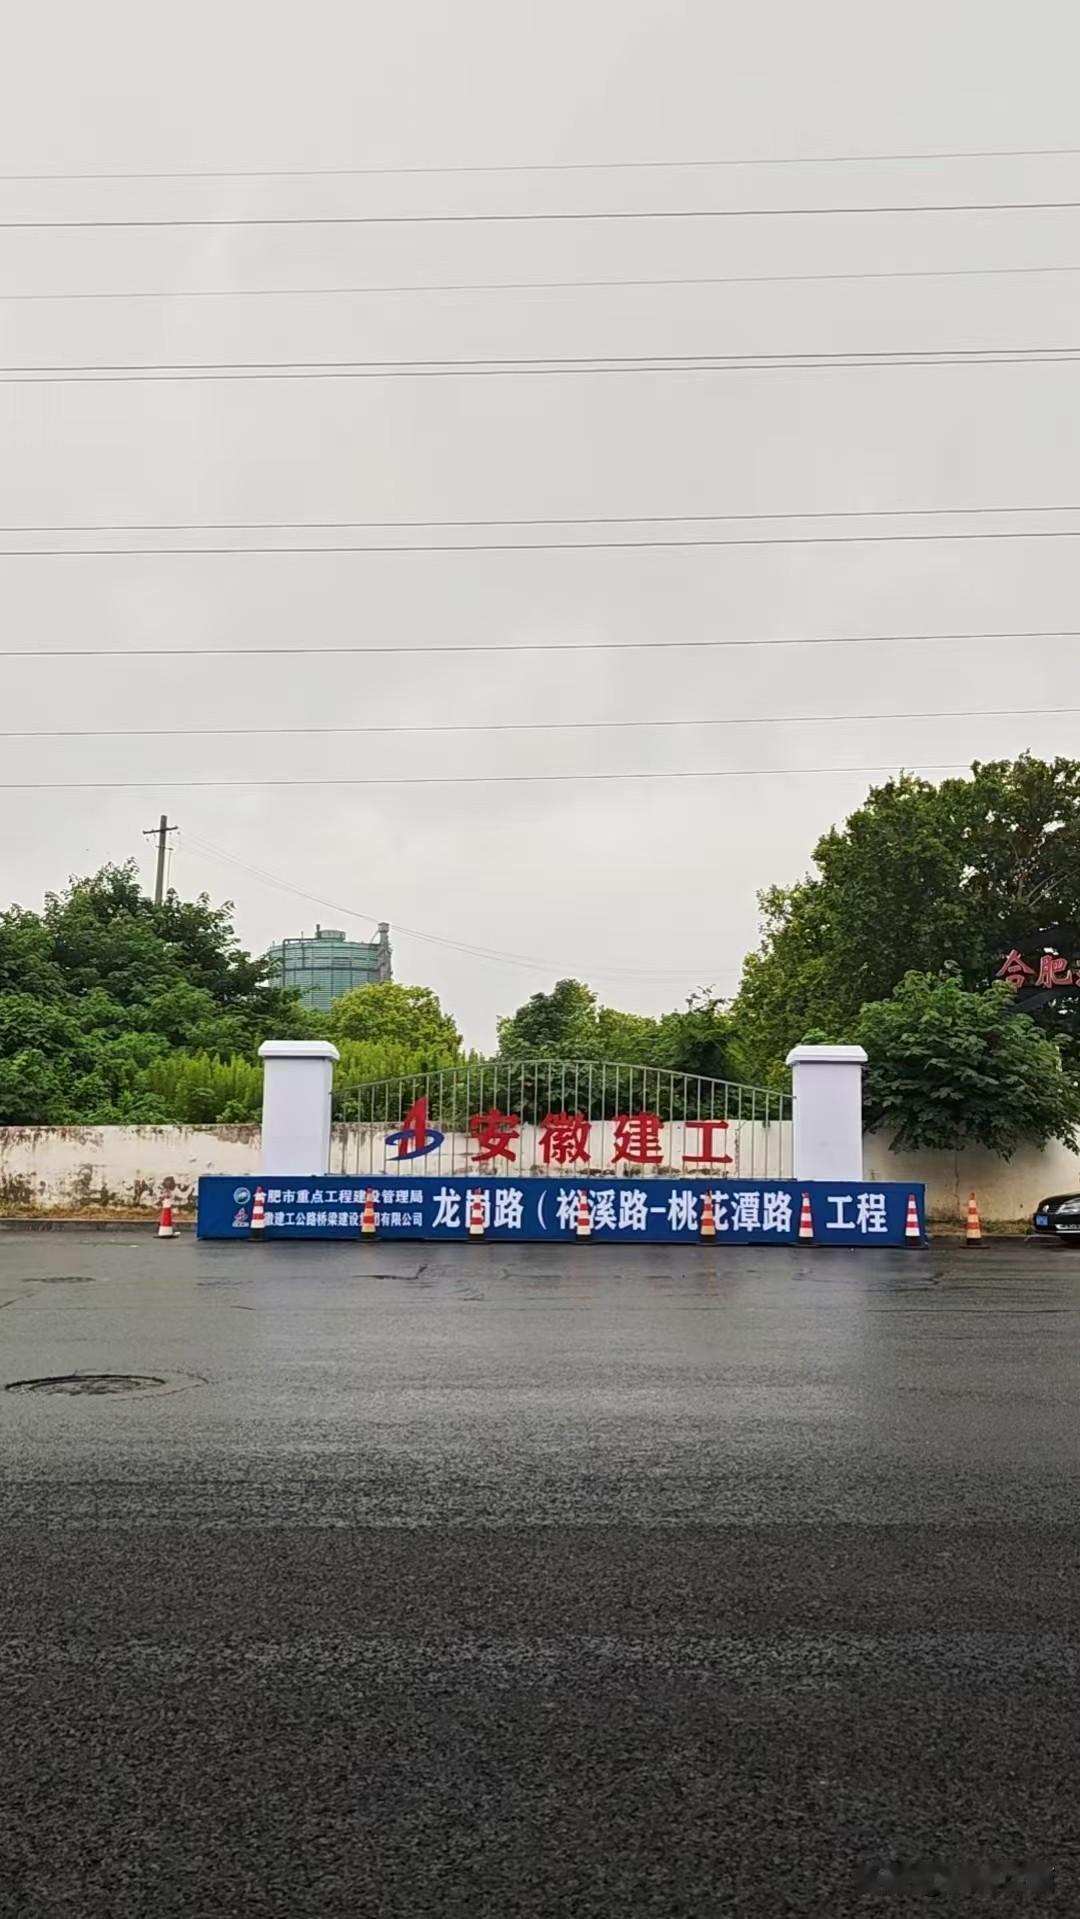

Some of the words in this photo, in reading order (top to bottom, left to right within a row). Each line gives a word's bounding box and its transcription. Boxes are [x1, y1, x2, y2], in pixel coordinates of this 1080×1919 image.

[995, 949, 1080, 992] 合肥
[470, 1107, 733, 1164] 安徽建工
[253, 1189, 423, 1204] 肥市重点工程建设管理局
[253, 1211, 423, 1227] 徽建工公路桥梁建设有限公司
